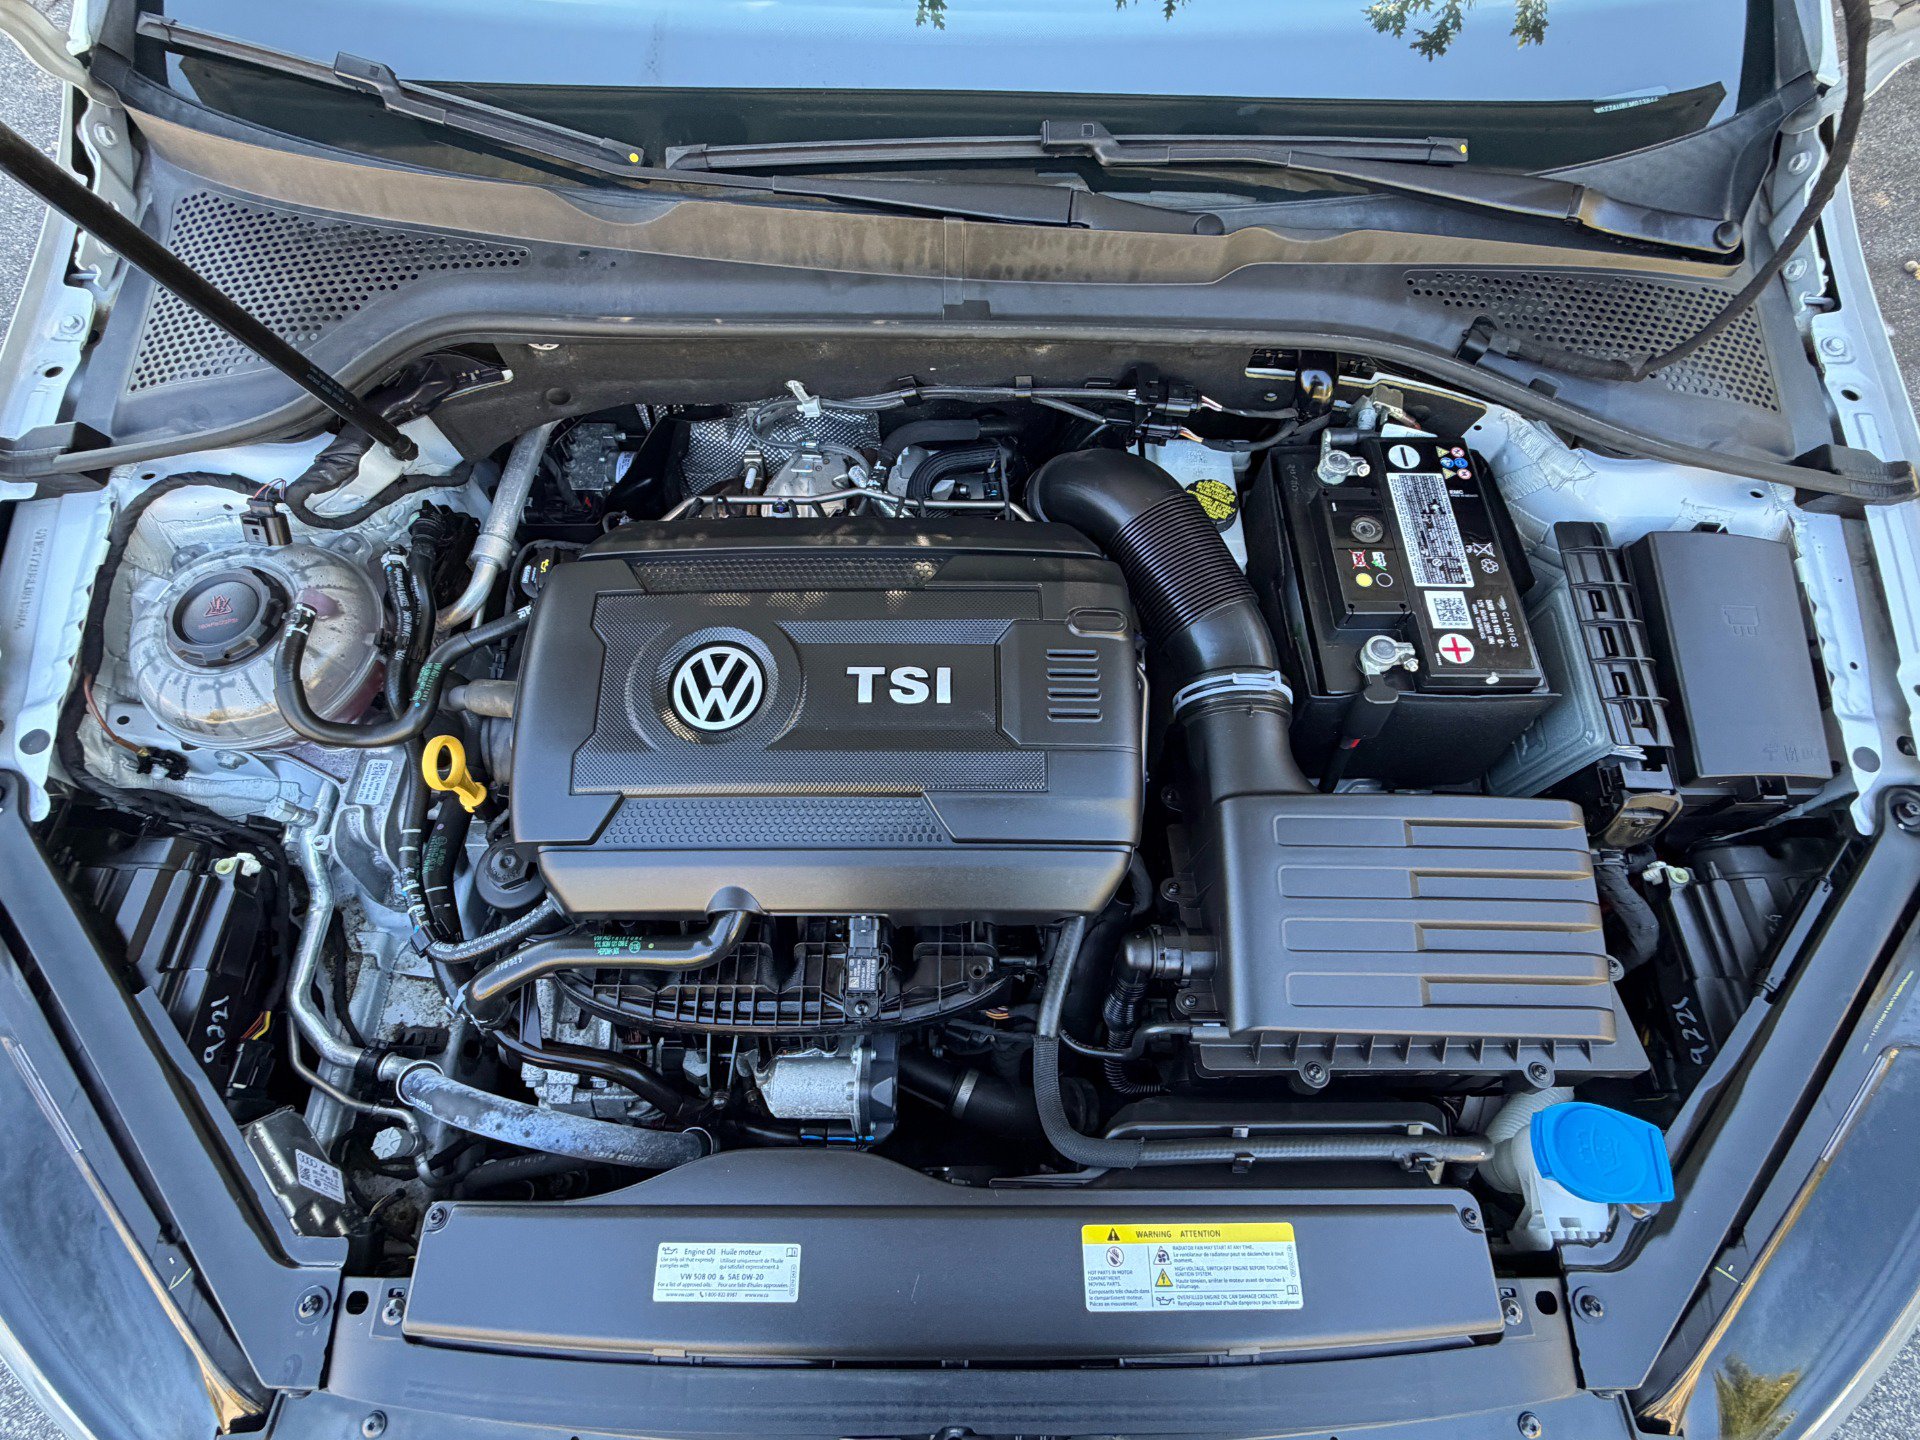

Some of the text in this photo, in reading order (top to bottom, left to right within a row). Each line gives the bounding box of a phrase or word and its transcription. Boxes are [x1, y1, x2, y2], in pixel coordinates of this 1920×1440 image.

[1501, 611, 1519, 648] CLARIOS
[846, 666, 952, 704] TSI
[1136, 1230, 1221, 1238] WARNING ATTENTION
[684, 1248, 706, 1257] Engine
